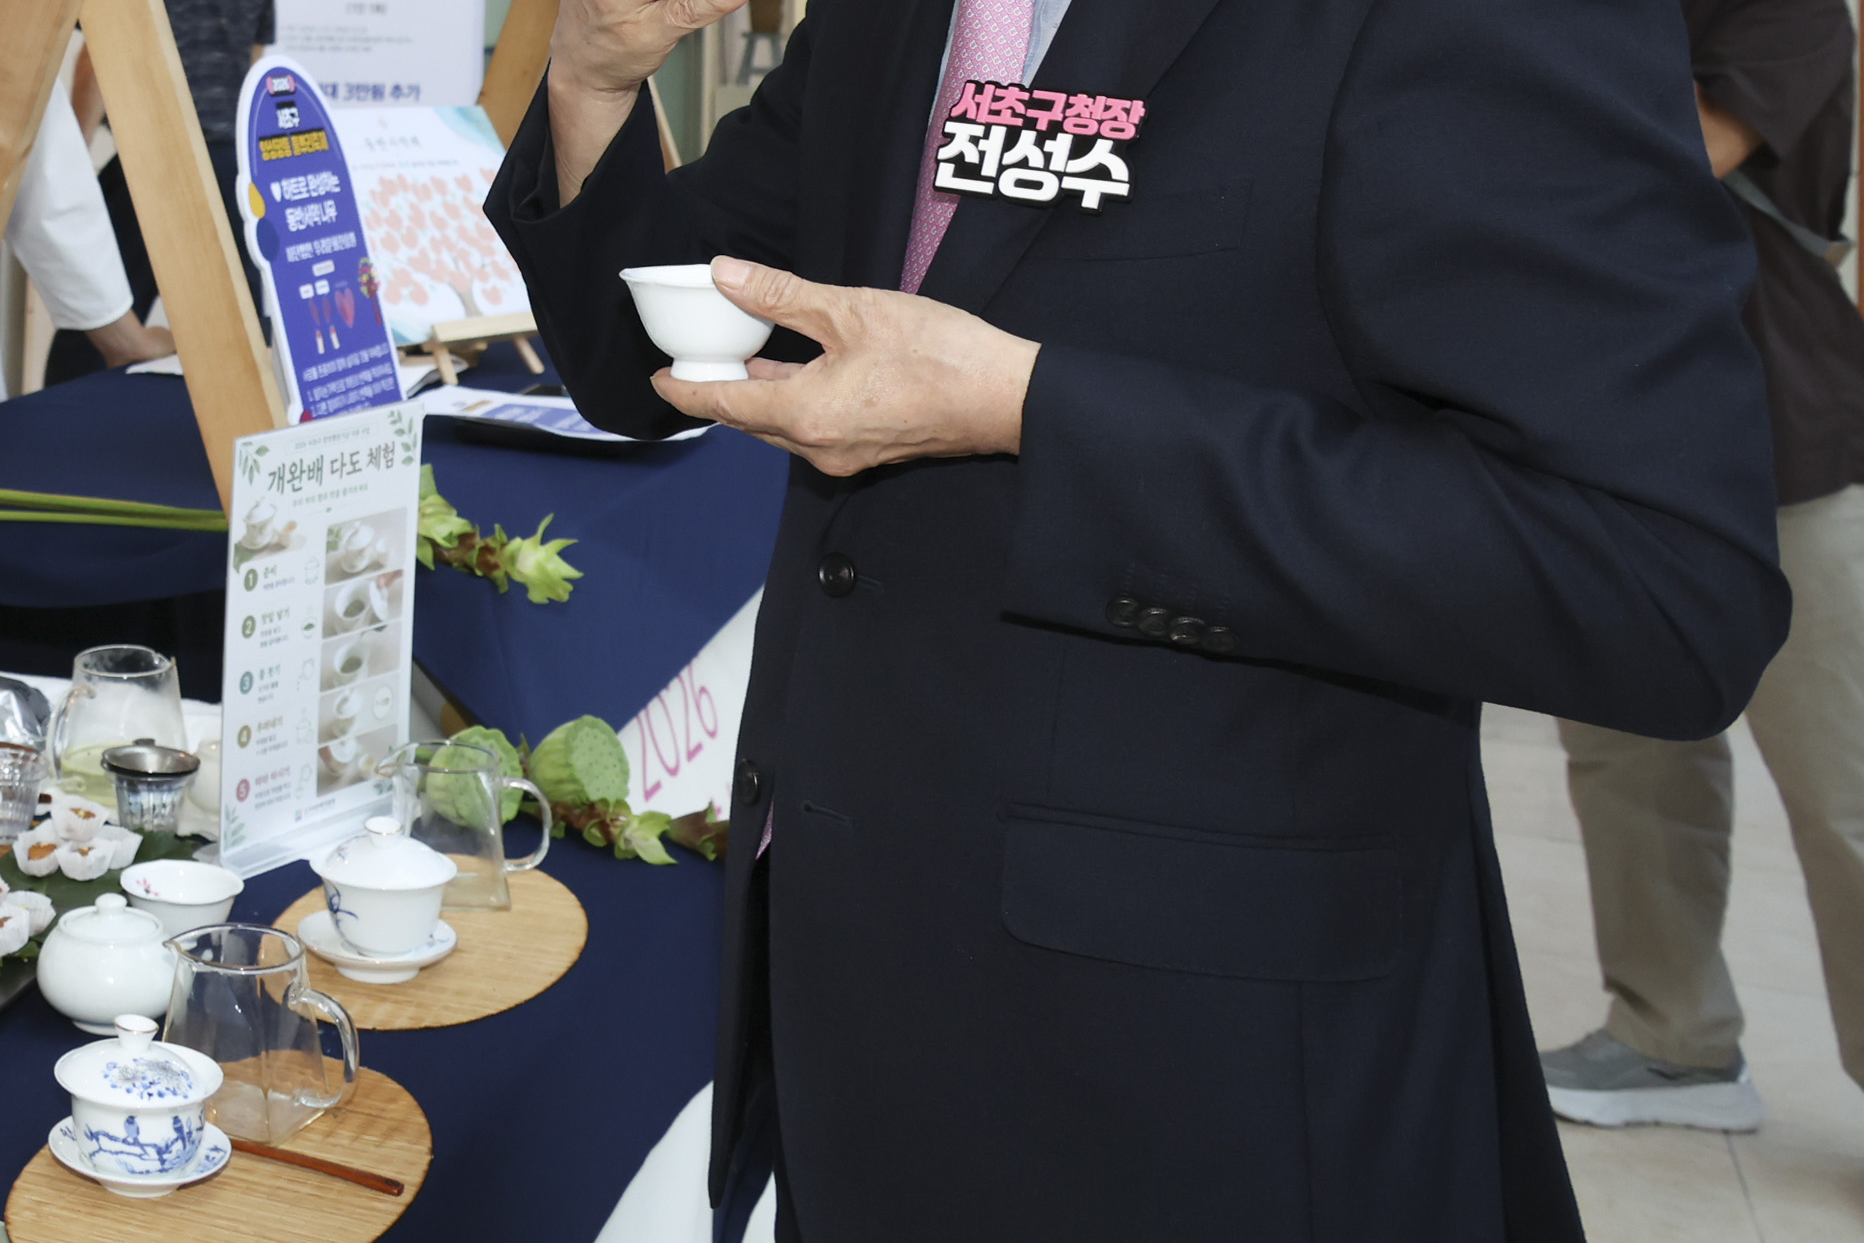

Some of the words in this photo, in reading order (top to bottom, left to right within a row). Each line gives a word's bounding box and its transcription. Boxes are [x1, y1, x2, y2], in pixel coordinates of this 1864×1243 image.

[343, 83, 385, 102] 3만원
[390, 84, 422, 103] 추가
[950, 82, 1146, 140] 서초구청장
[281, 176, 310, 201] 하트로
[306, 170, 341, 197] 완성하는
[935, 121, 1130, 210] 전성수
[268, 454, 324, 495] 개완배
[330, 451, 363, 480] 다도
[366, 440, 396, 471] 체험
[636, 662, 718, 802] 2026
